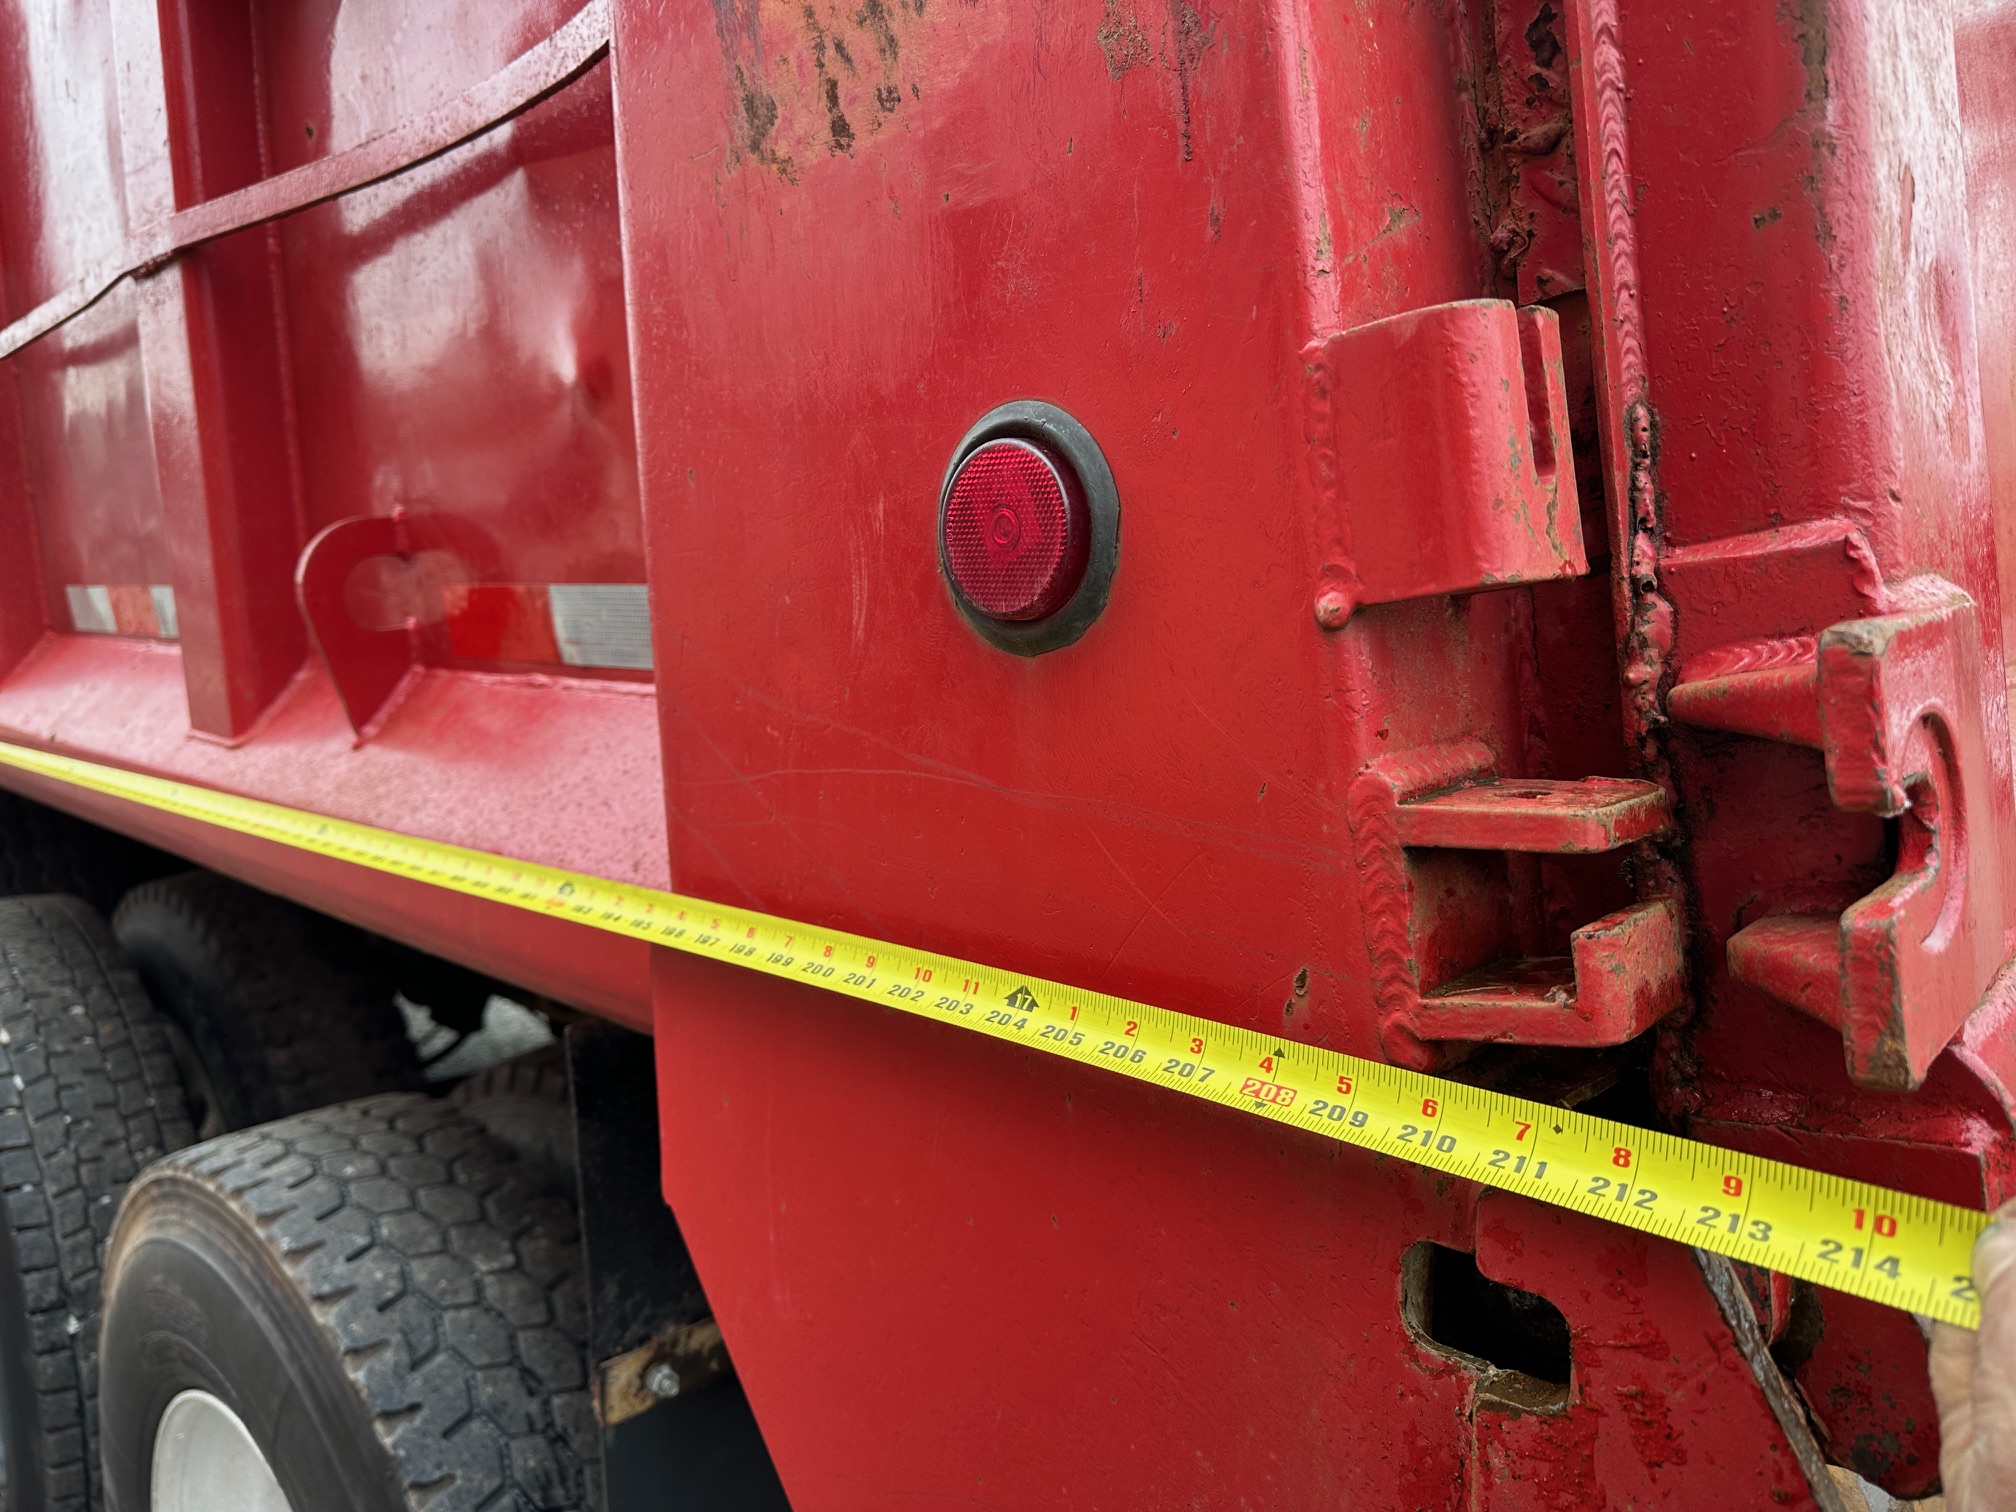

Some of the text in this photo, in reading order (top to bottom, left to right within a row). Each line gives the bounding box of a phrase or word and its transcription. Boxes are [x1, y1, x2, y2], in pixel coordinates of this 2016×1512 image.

[645, 902, 654, 913] 3
[677, 910, 686, 920] 4
[711, 918, 720, 929] 5
[746, 927, 756, 938] 6
[784, 935, 794, 947] 7
[823, 944, 834, 958] 8
[866, 955, 876, 968] 9
[914, 966, 933, 983] 10
[962, 978, 980, 995] 11
[1013, 992, 1032, 1011] 17
[1070, 1005, 1079, 1021] 1
[1124, 1020, 1139, 1037] 2
[1189, 1037, 1204, 1055] 3
[1258, 1056, 1274, 1074] 4
[1336, 1075, 1353, 1095] 5
[1421, 1098, 1438, 1118] 6
[1514, 1120, 1532, 1141] 7
[1612, 1146, 1632, 1169] 8
[1722, 1175, 1743, 1198] 9
[1853, 1208, 1898, 1239] 10
[694, 933, 720, 947] 197
[728, 942, 757, 957] 198
[766, 952, 795, 967] 199
[801, 961, 836, 979] 200
[843, 972, 877, 990] 201
[887, 984, 925, 1003] 202
[934, 996, 974, 1016] 203
[984, 1009, 1029, 1032] 204
[1039, 1024, 1087, 1047] 205
[1098, 1040, 1148, 1065] 206
[1161, 1058, 1216, 1085] 207
[1243, 1079, 1295, 1107] 208
[1308, 1099, 1369, 1128] 209
[1396, 1124, 1457, 1154] 210
[1487, 1149, 1549, 1180] 211
[1587, 1176, 1659, 1211] 212
[1695, 1205, 1773, 1243] 213
[1817, 1238, 1903, 1280] 214
